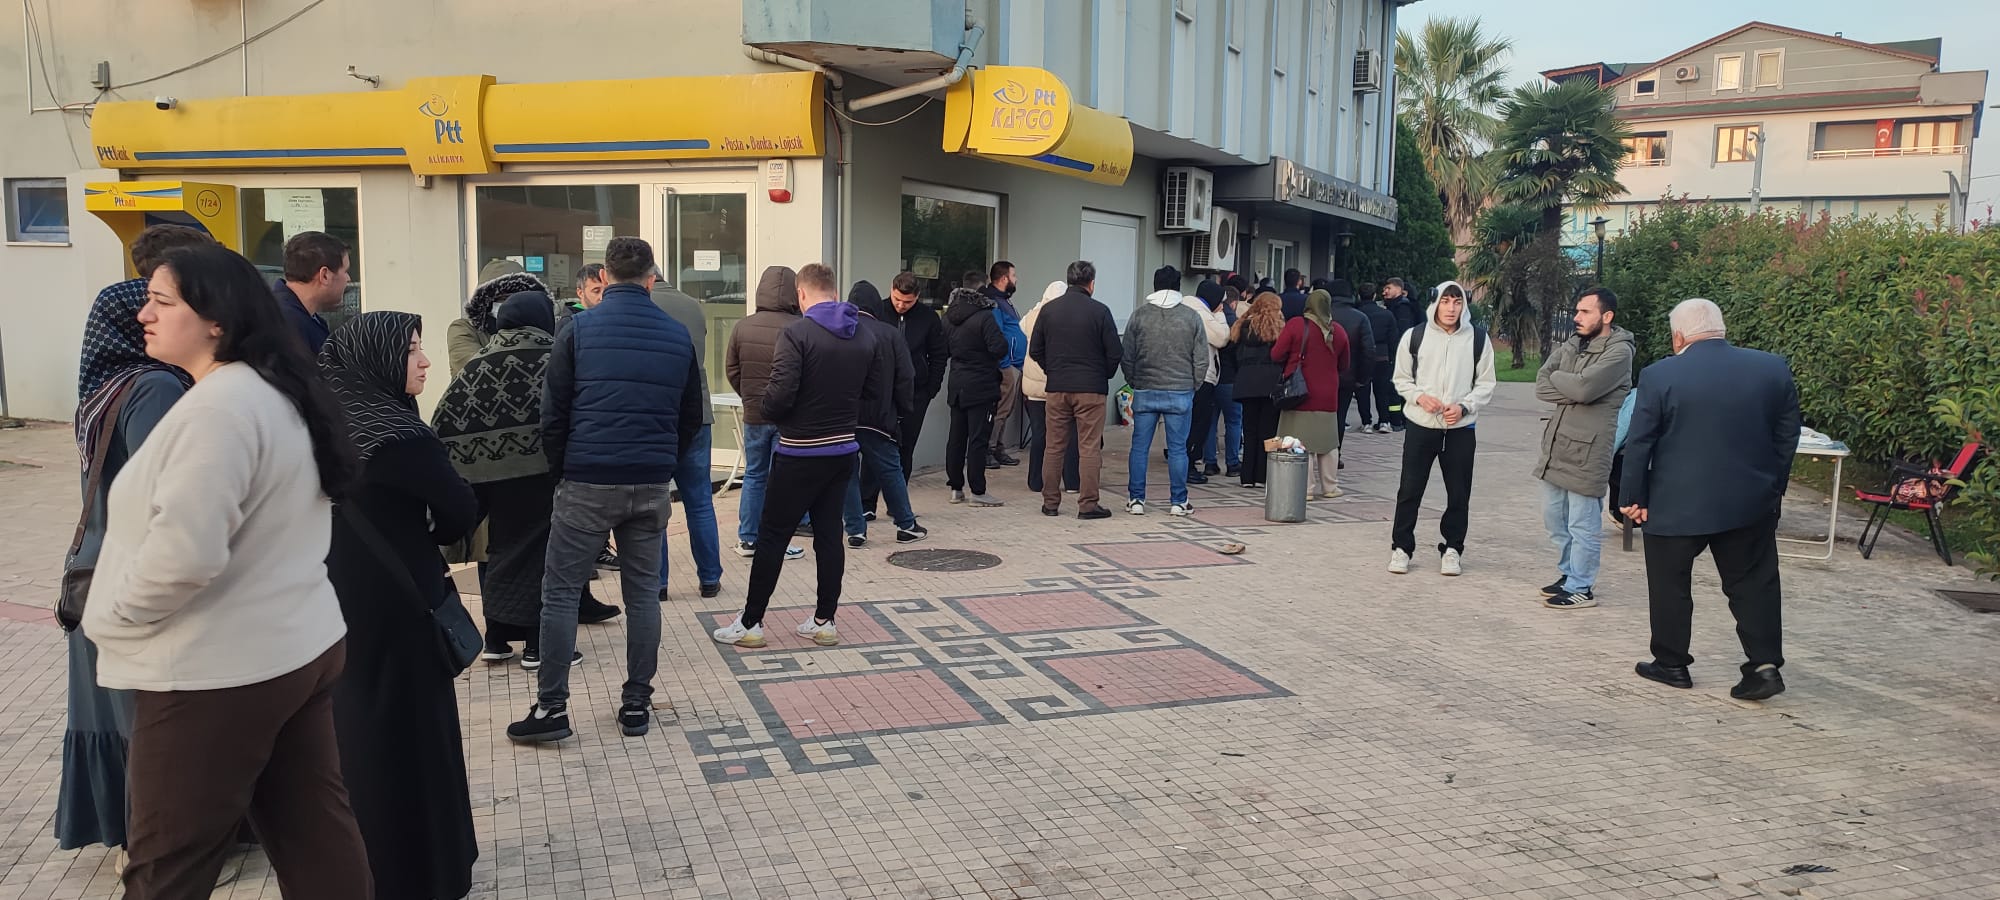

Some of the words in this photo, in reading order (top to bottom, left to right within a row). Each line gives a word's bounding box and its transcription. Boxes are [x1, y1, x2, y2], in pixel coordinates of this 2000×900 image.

[1033, 88, 1057, 106] Ptt
[991, 107, 1054, 131] KARGO
[434, 118, 464, 145] Ptt
[724, 136, 745, 151] Posta
[749, 135, 773, 151] Banka
[778, 135, 804, 152] Lojistik
[200, 197, 218, 208] 7/24
